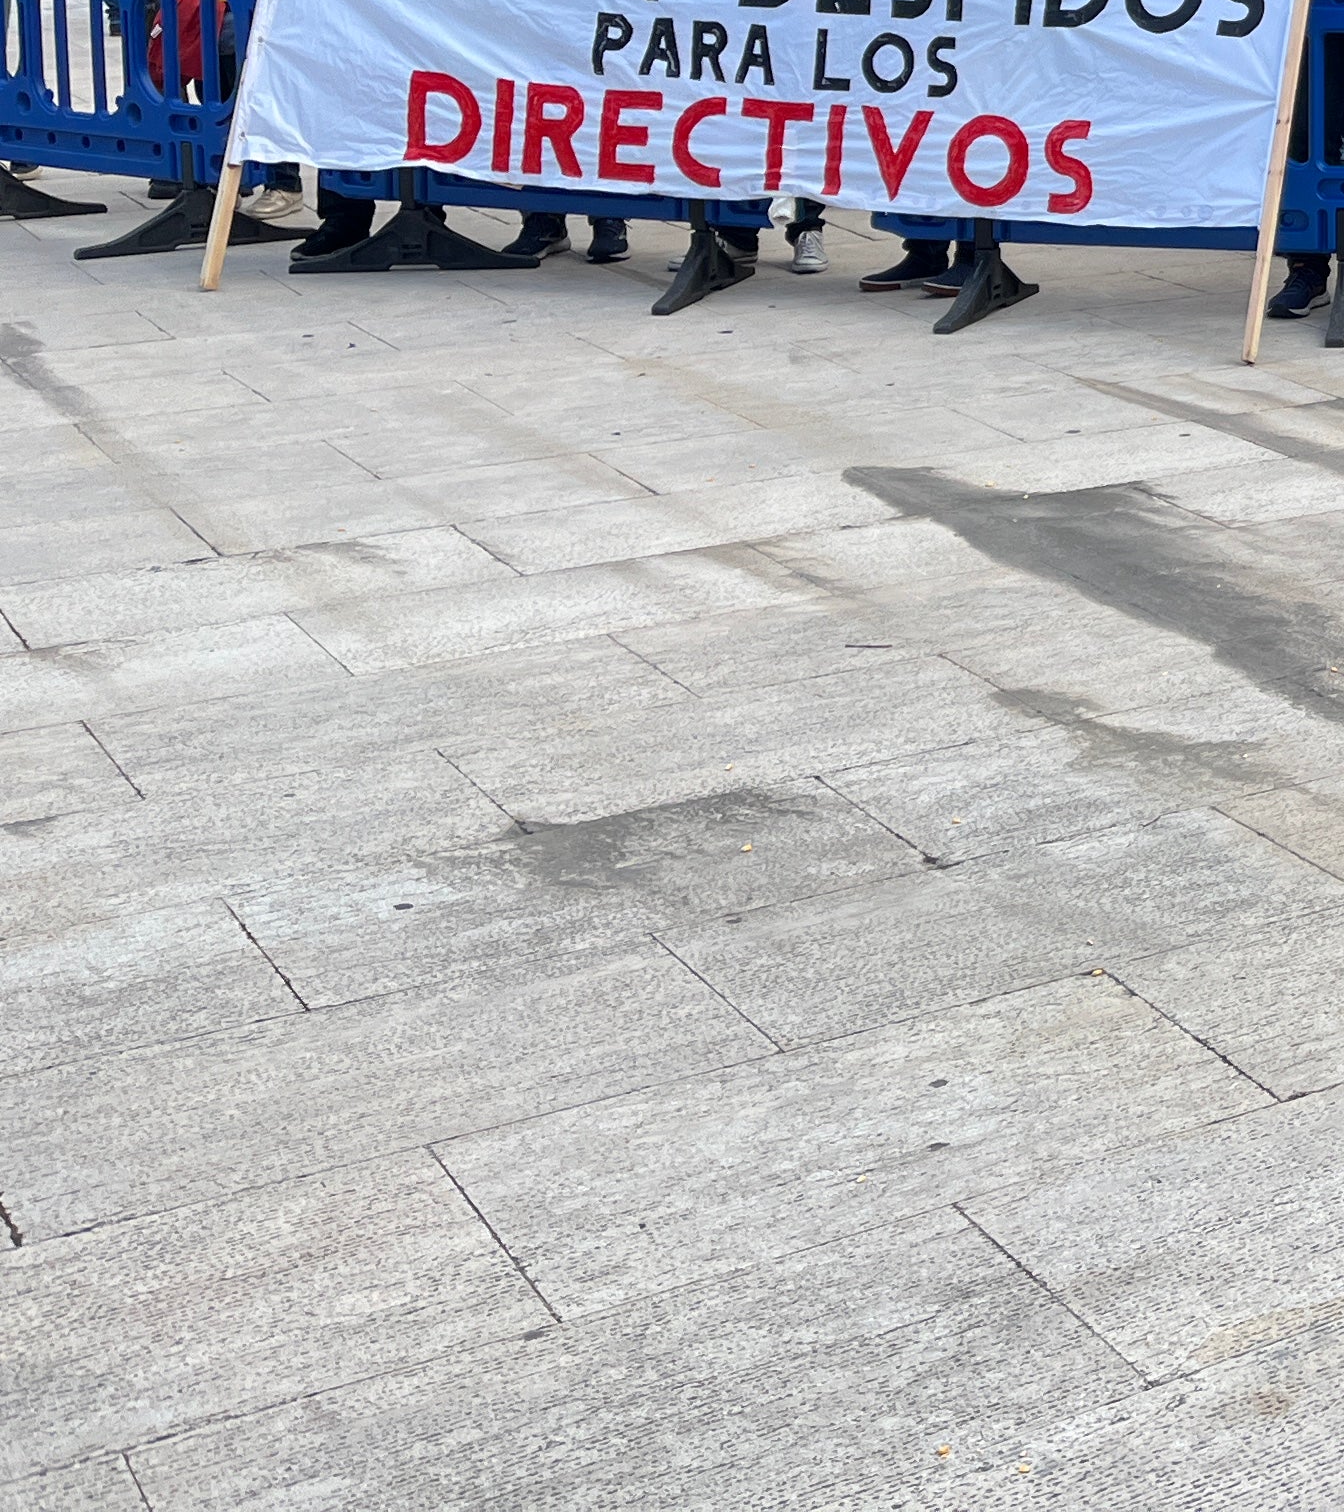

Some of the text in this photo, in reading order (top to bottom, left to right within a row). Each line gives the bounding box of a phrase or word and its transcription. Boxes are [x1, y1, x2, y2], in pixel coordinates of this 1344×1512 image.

[591, 12, 957, 98] PARA LOS
[403, 70, 1094, 215] DIRECTIVOS
